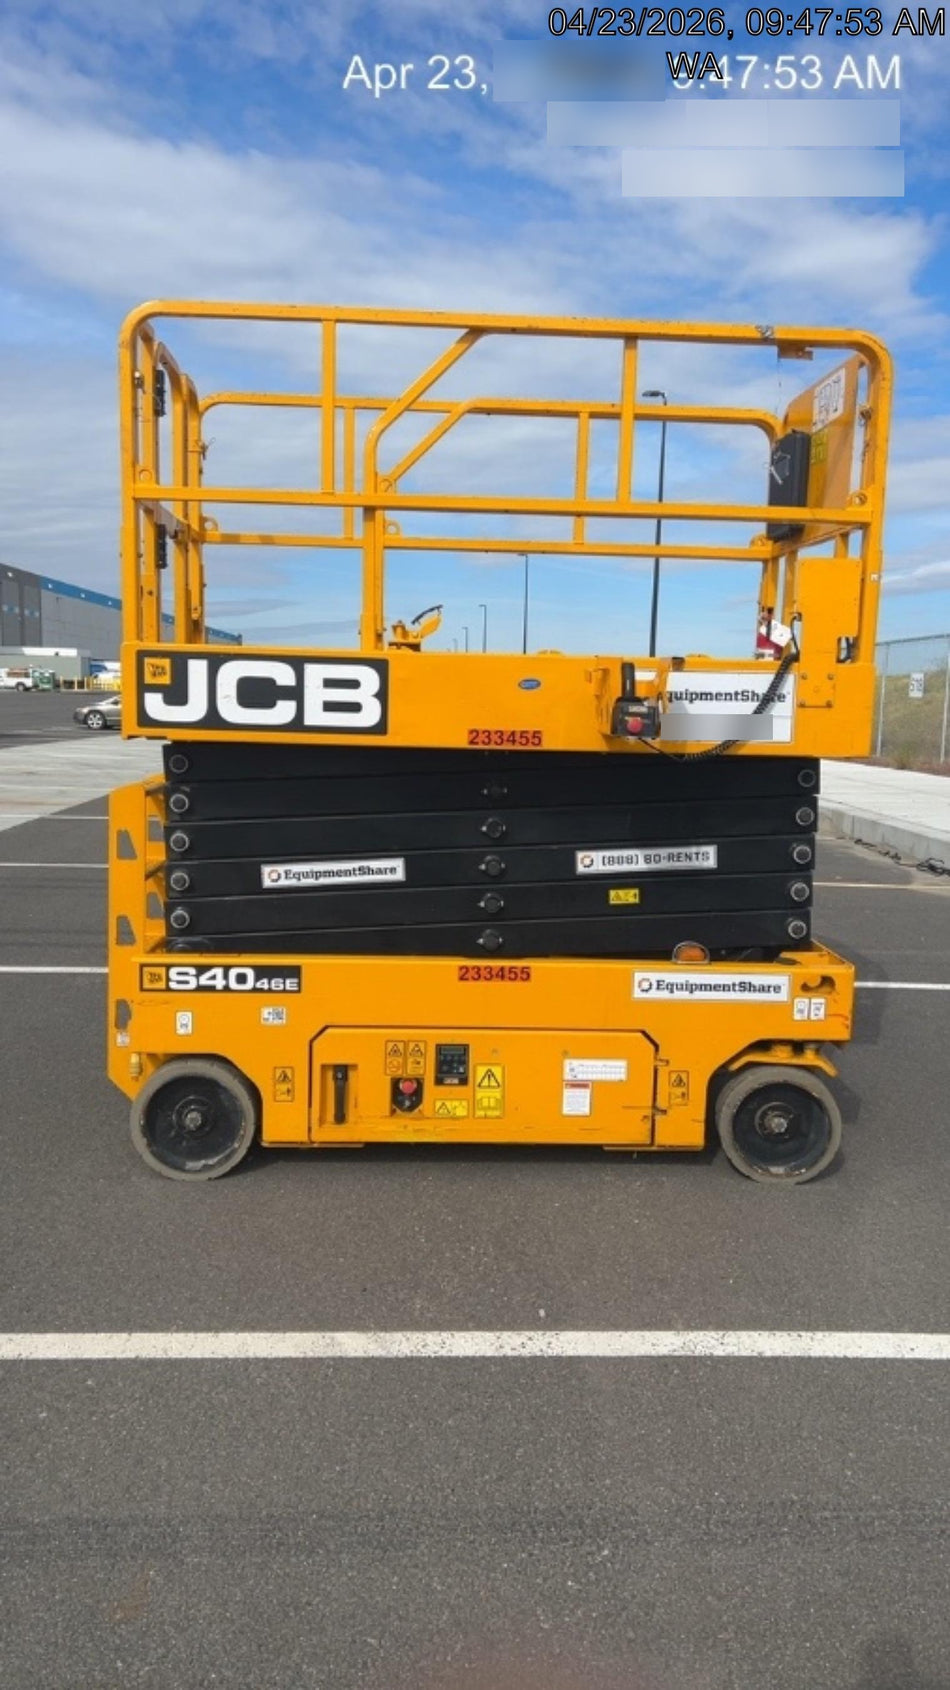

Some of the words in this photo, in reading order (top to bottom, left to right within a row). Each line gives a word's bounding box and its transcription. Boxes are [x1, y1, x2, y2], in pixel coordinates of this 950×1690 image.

[144, 658, 382, 727] JCB
[468, 729, 543, 747] 233455
[283, 864, 398, 882] EquipmentShare
[458, 965, 532, 982] 233455
[655, 979, 782, 995] EquipmentShare
